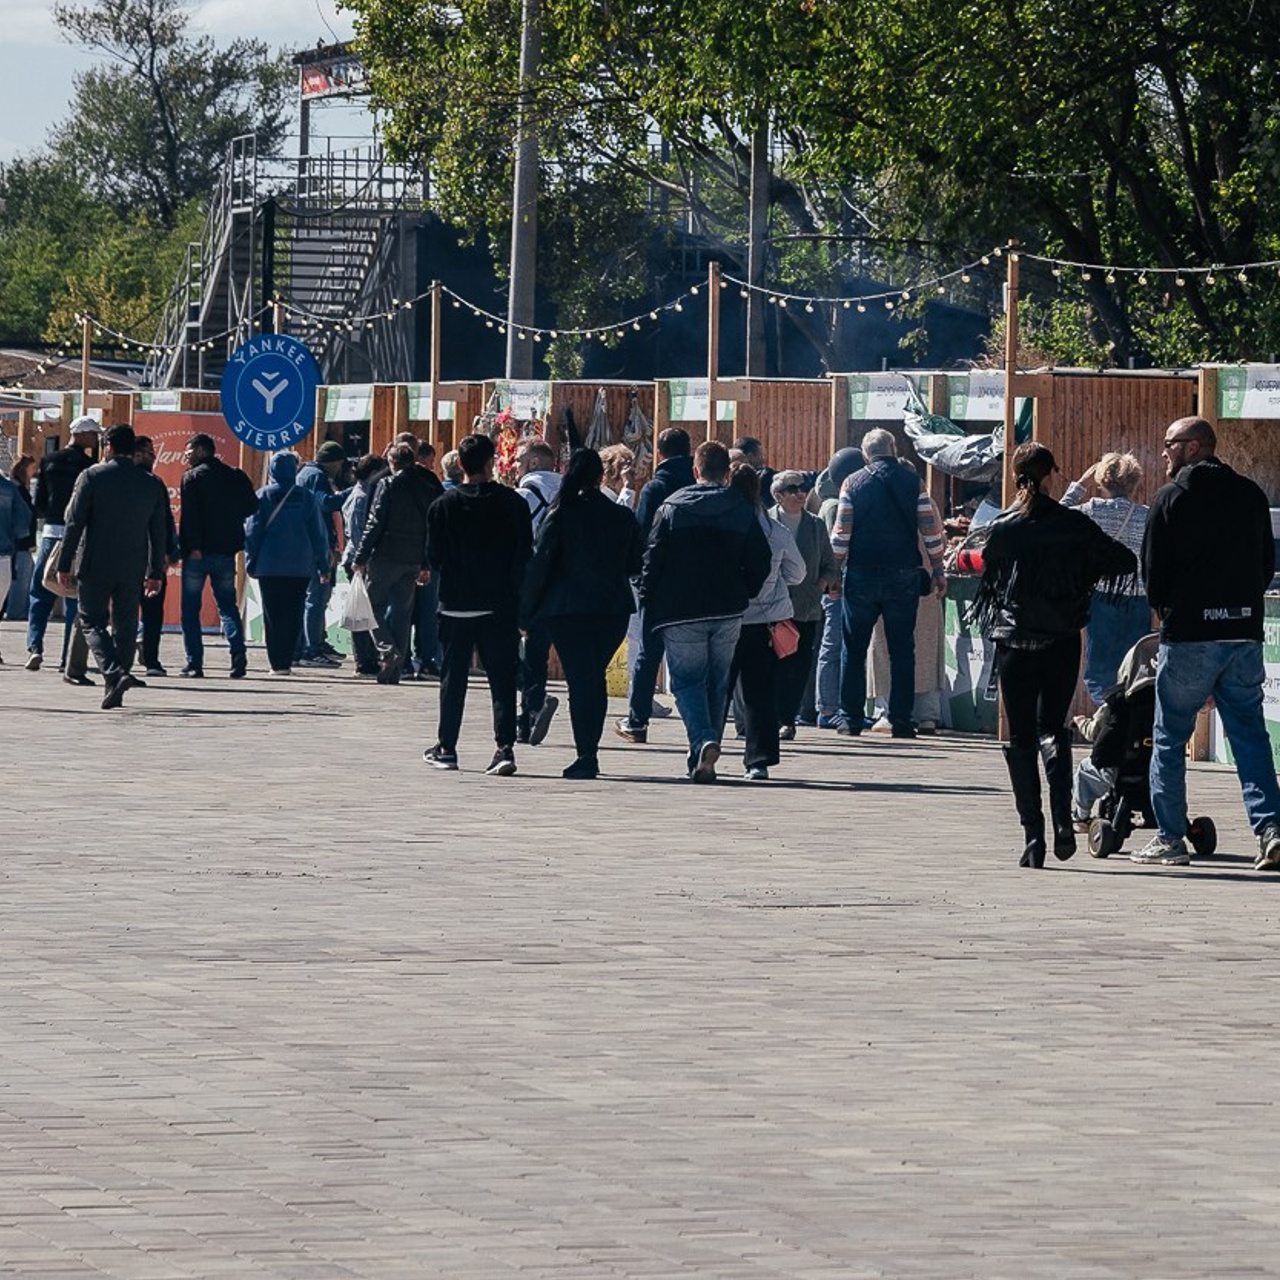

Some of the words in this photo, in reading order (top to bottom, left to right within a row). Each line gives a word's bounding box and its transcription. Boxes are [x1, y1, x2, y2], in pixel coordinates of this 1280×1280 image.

[233, 339, 305, 365] YANKEE
[234, 420, 304, 447] SIERRA
[1203, 608, 1229, 620] PUMA
